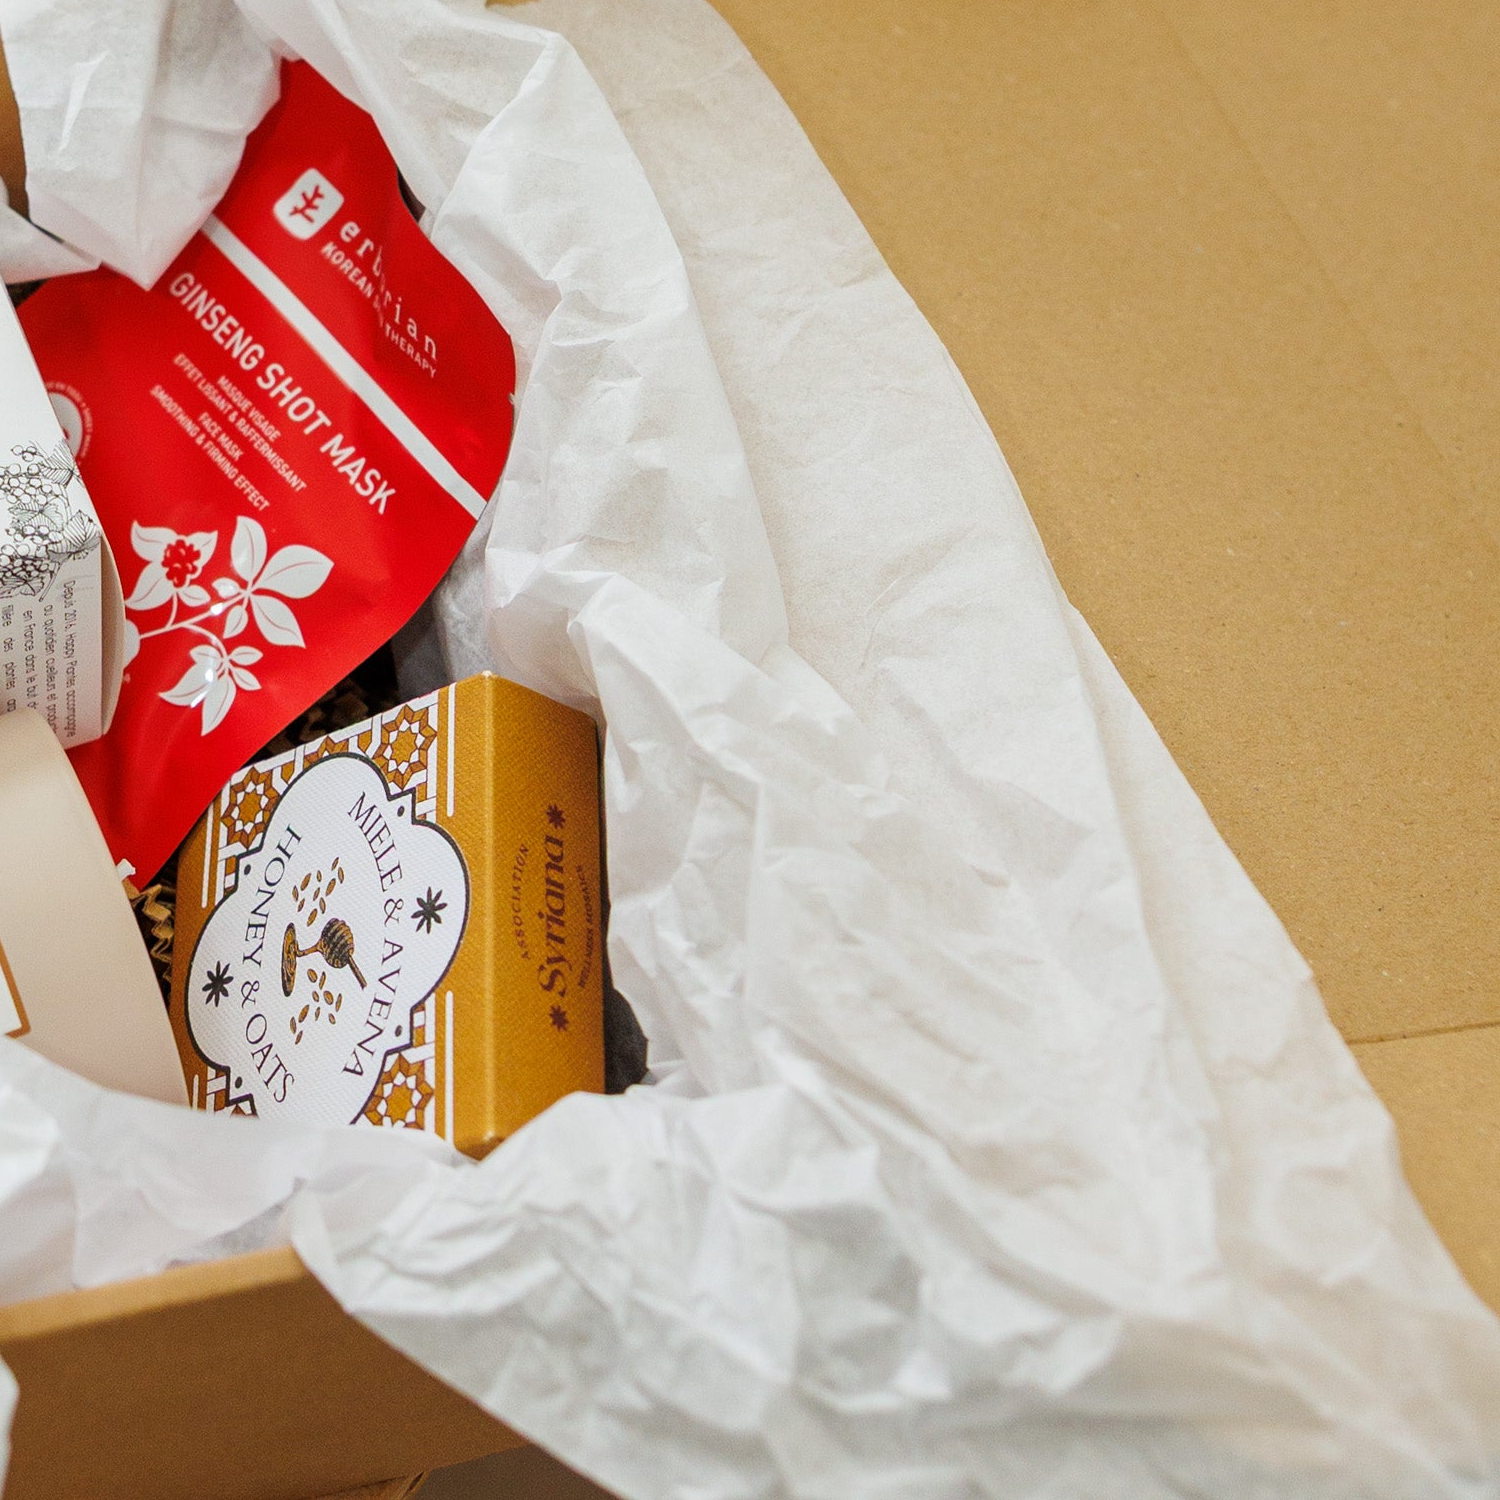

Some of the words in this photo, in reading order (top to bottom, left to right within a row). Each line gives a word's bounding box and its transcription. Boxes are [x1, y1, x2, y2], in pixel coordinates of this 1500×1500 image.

[319, 240, 378, 299] KOREAN
[386, 323, 436, 377] THERAPY
[169, 272, 265, 371] GINSENG
[256, 363, 332, 436] SHOT
[320, 433, 397, 516] MASK
[171, 352, 204, 385] EFFET
[195, 377, 234, 417] LISSANT
[232, 416, 305, 494] RAFFERMISSANT
[196, 411, 223, 438] FACE
[215, 431, 245, 462] MASK
[214, 374, 253, 414] MASQUE
[245, 406, 282, 444] VISAGE
[147, 383, 202, 441] SMOOTHING
[200, 439, 240, 481] FIRMING
[231, 473, 270, 513] EFFECT
[1, 636, 15, 652] des
[21, 623, 35, 652] France
[61, 633, 76, 659] Happy
[63, 659, 77, 688] Plantes
[346, 791, 404, 892] MIELE
[242, 824, 302, 968] HONEY
[383, 897, 405, 925] &
[508, 842, 531, 961] ASSOCIATION
[539, 833, 568, 1000] Syriana
[240, 980, 261, 1008] &
[341, 938, 404, 1078] AVENA
[245, 1013, 296, 1104] OATS
